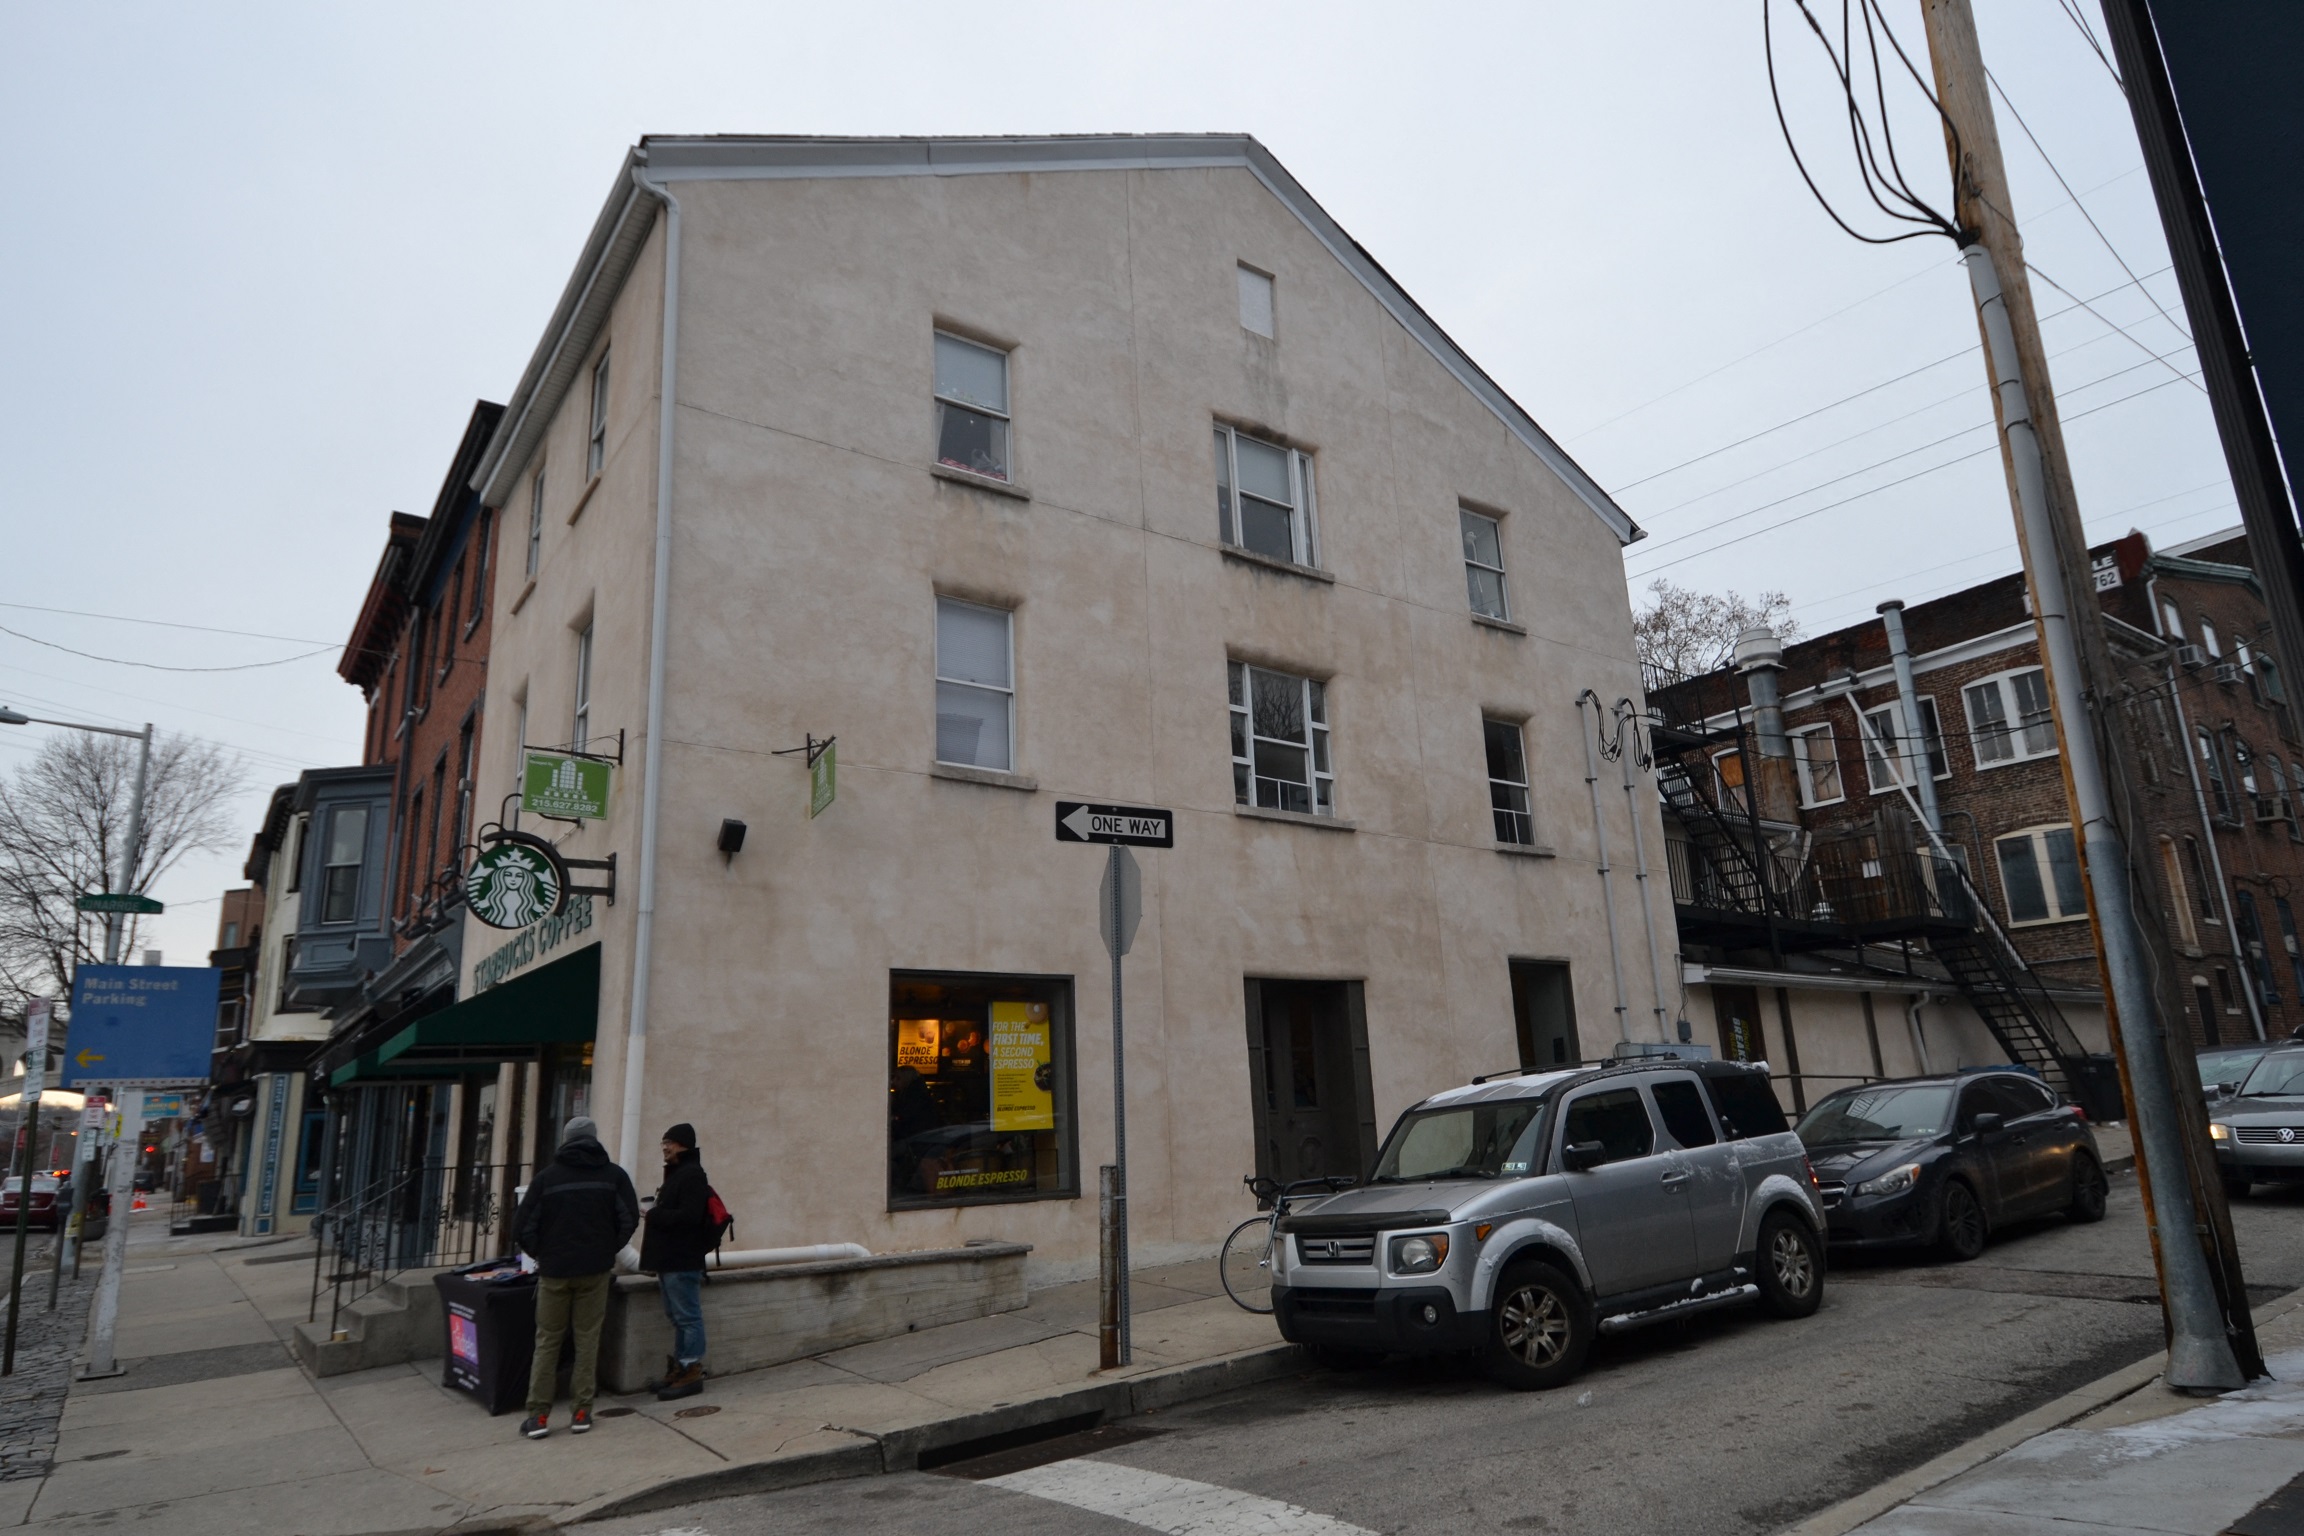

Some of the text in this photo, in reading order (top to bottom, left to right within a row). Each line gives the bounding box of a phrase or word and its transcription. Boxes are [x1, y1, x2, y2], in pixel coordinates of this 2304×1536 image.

[531, 798, 598, 812] 215.627.8282
[1091, 816, 1161, 835] ONE WAY
[473, 895, 592, 994] STARBUCKS COFFEE
[84, 978, 179, 991] Main Street
[82, 992, 147, 1006] Parking
[992, 1021, 1026, 1032] FOR THE
[992, 1033, 1044, 1047] FIRST TIME,
[900, 1046, 931, 1055] BLONDE
[992, 1047, 1034, 1057] A SECOND
[898, 1056, 940, 1064] ESPRESSO
[993, 1059, 1035, 1069] ESPRESSO
[936, 1174, 977, 1190] BLONDE
[977, 1169, 1028, 1185] ESPRESSO
